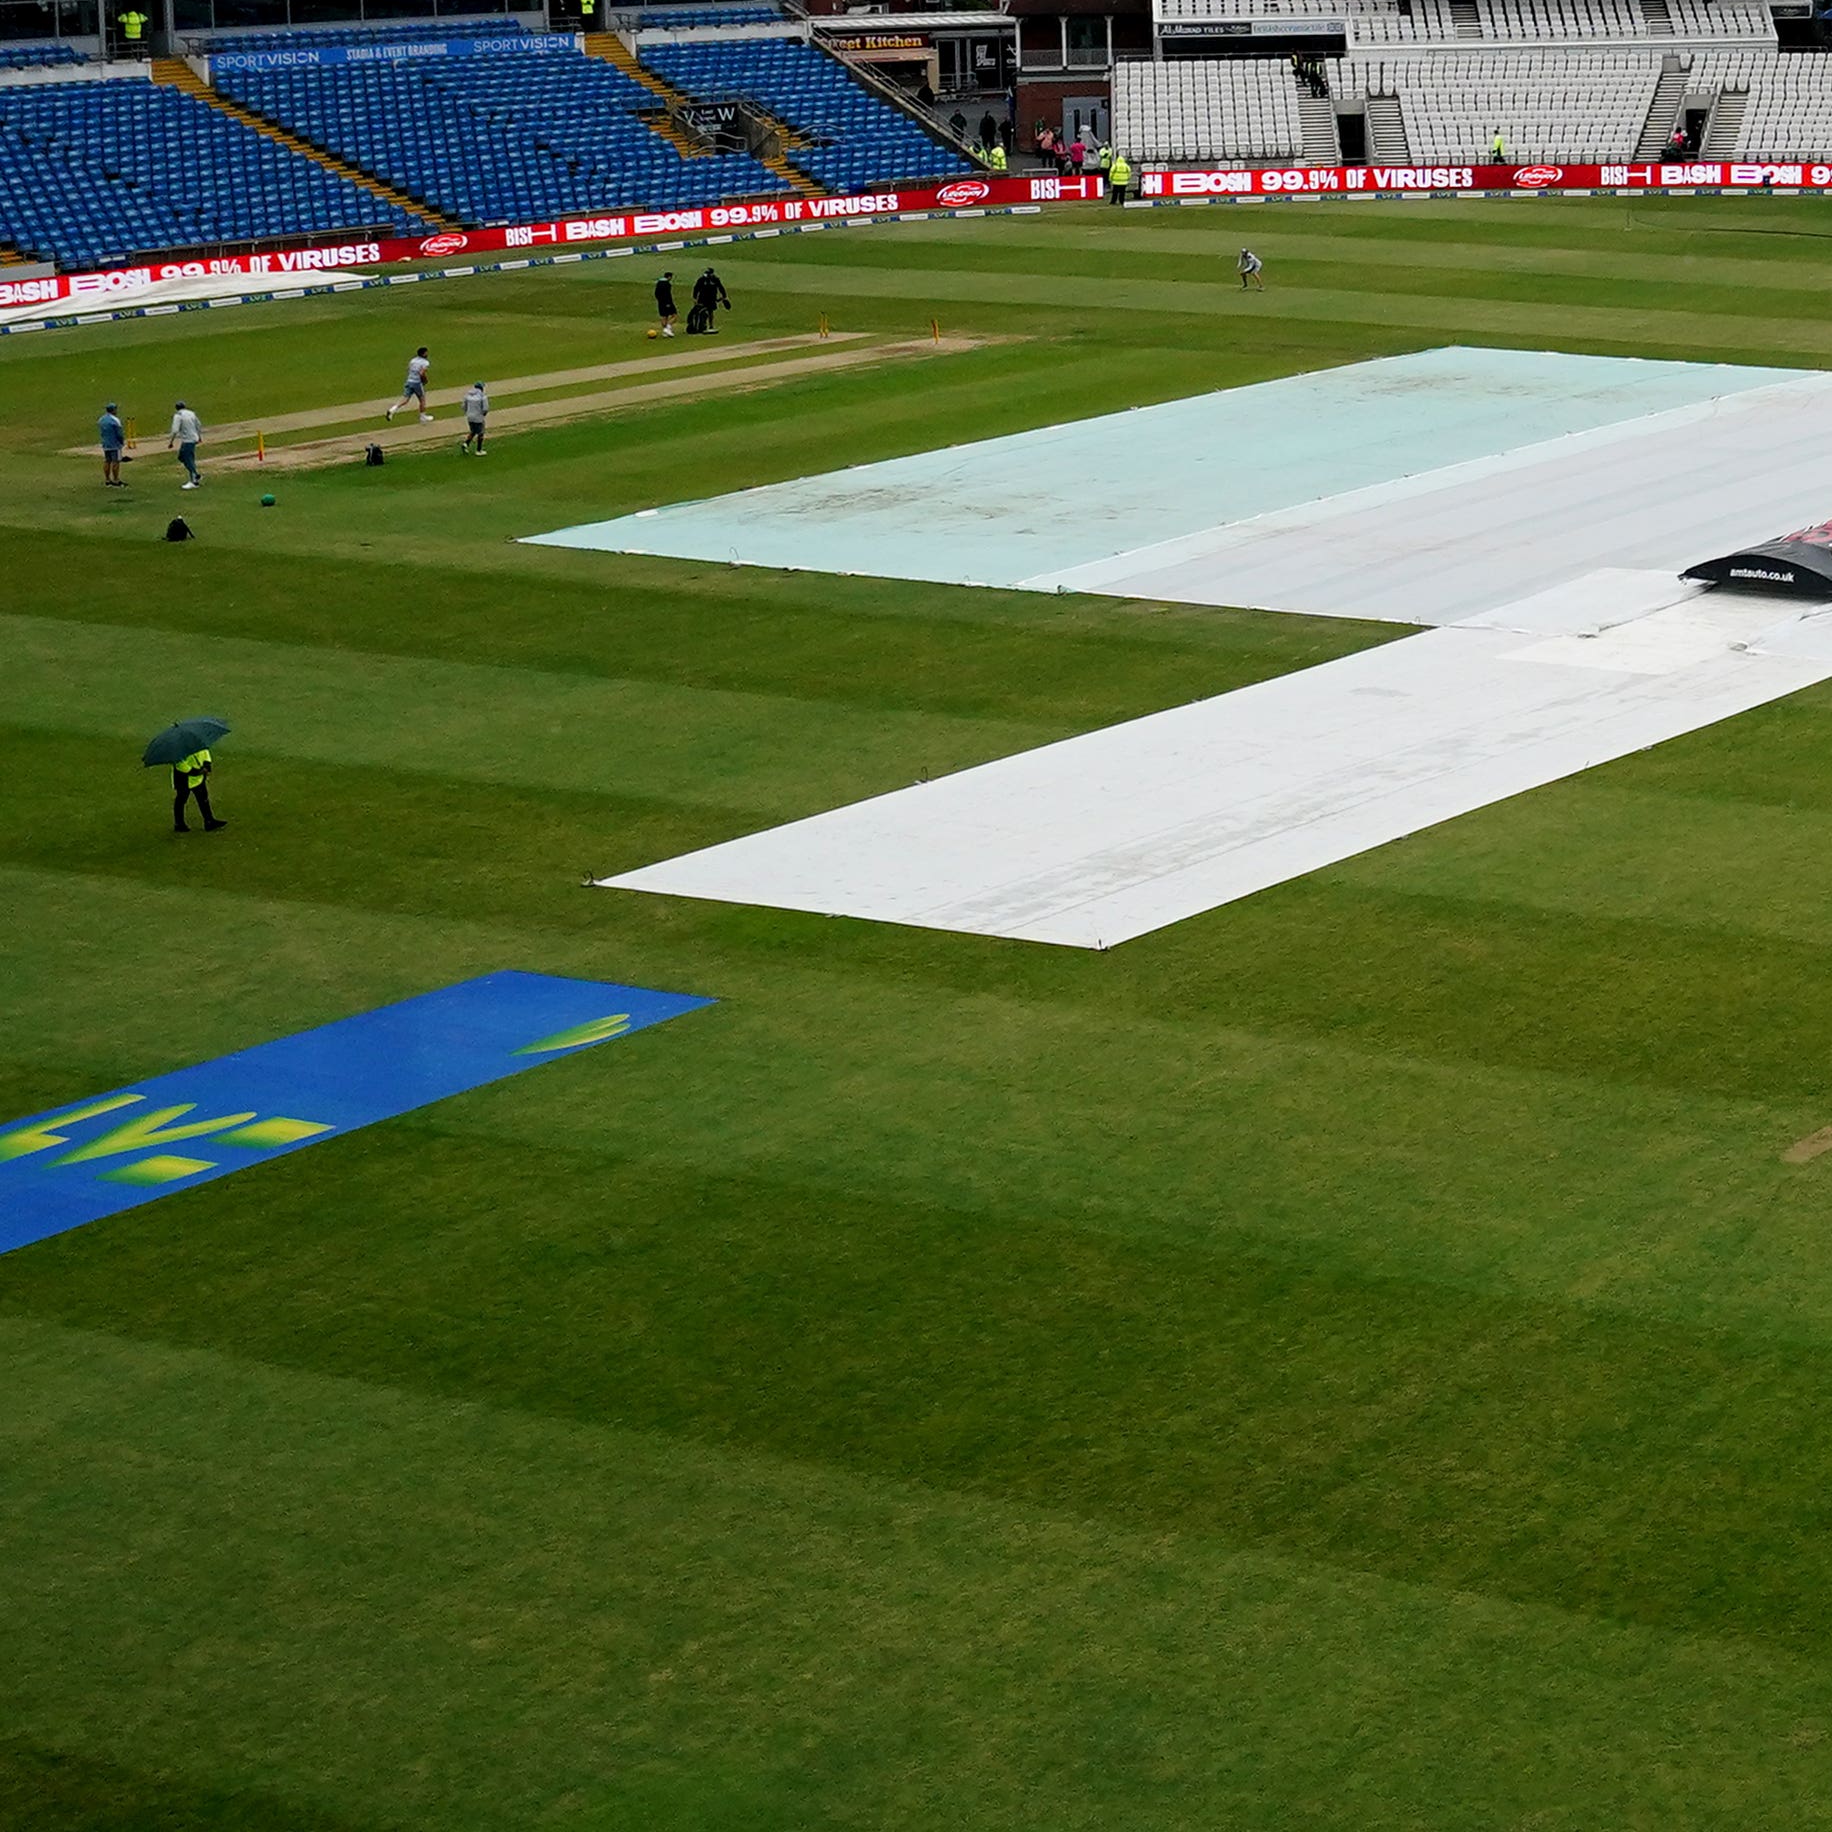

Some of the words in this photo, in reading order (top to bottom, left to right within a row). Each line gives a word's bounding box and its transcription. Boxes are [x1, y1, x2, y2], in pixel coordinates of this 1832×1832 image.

[865, 35, 922, 49] Kitchen
[1173, 172, 1252, 194] BOSH
[1261, 170, 1338, 191] 99.9%
[1348, 168, 1369, 189] OF
[1374, 167, 1473, 188] VIRUSES
[1602, 166, 1651, 185] BISH
[1661, 164, 1721, 184] BASH
[1730, 164, 1802, 184] BOSH
[1030, 177, 1086, 200] BISH
[506, 224, 556, 247] BISH
[566, 217, 625, 240] BASH
[634, 211, 702, 233] BOSH
[710, 204, 778, 226] 99.9%
[785, 202, 802, 218] OF
[807, 194, 898, 217] VIRUSES
[69, 268, 151, 293] BOSH
[250, 255, 272, 273] OF
[278, 243, 380, 271] VIRUSES
[1730, 567, 1795, 583] amtauto.co.uk
